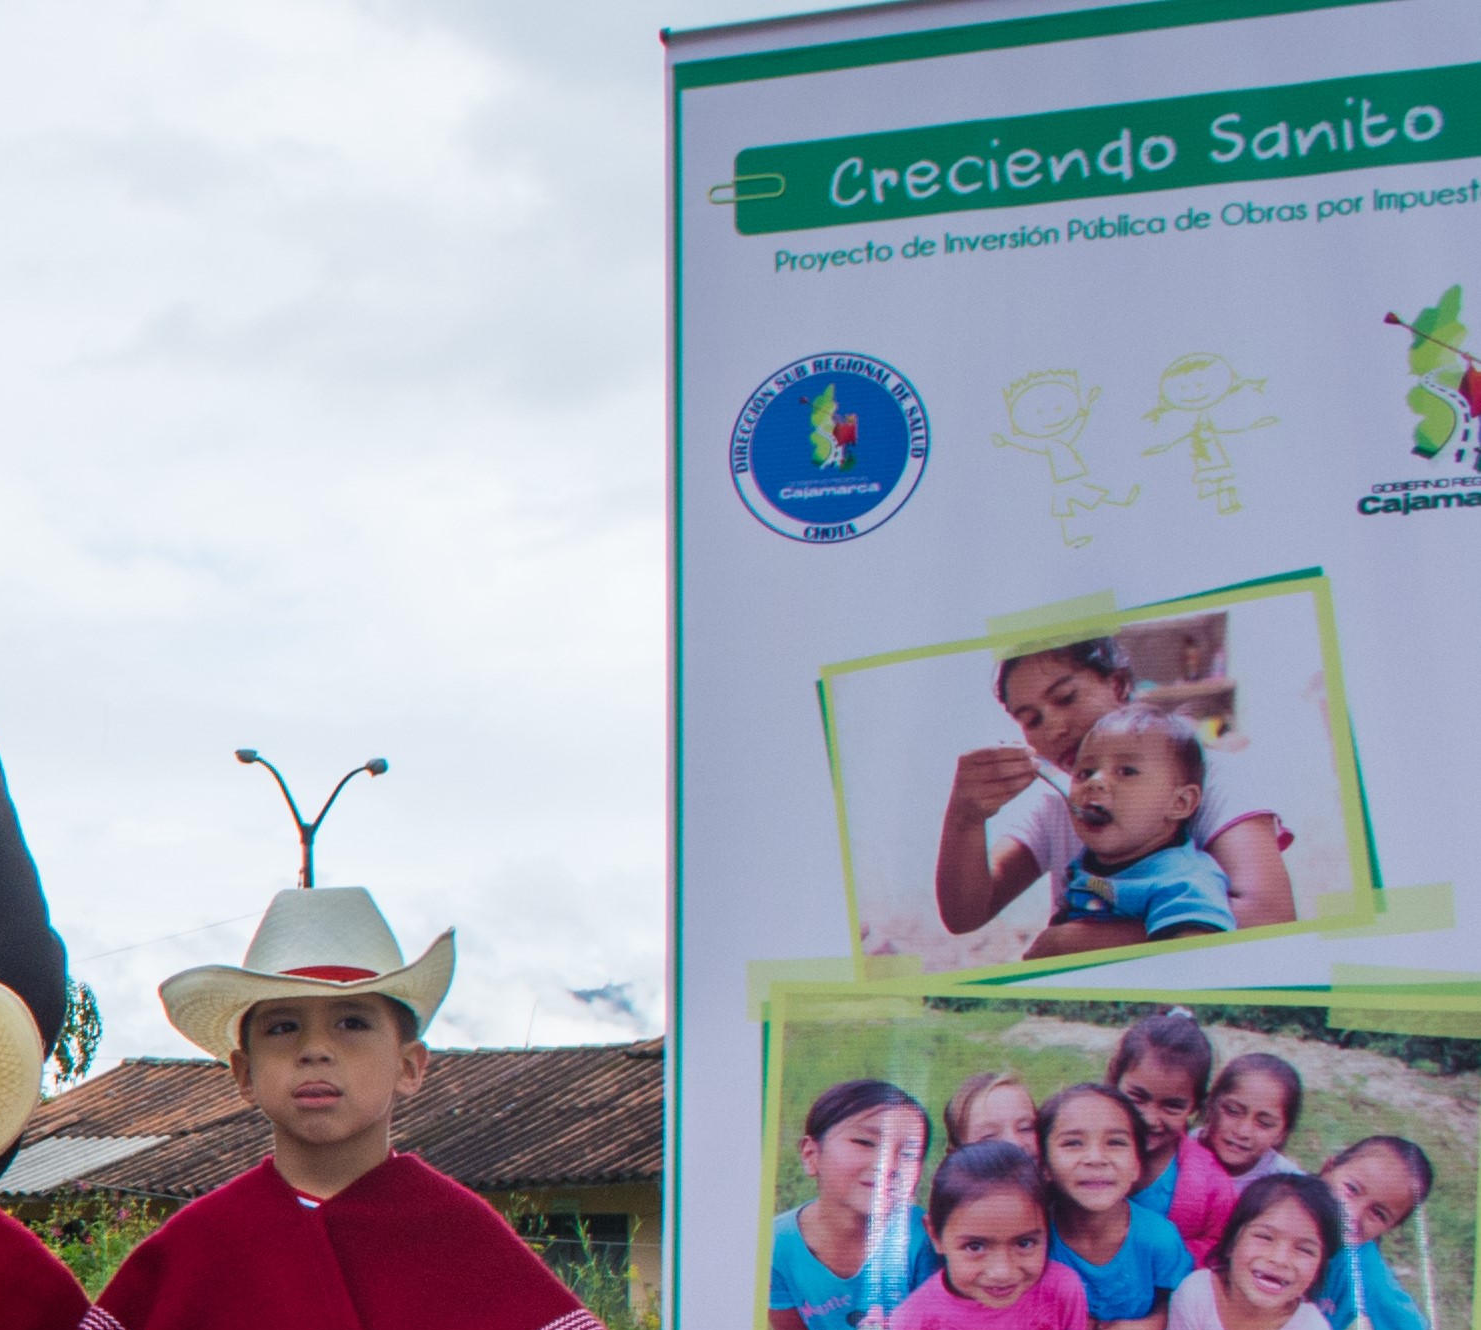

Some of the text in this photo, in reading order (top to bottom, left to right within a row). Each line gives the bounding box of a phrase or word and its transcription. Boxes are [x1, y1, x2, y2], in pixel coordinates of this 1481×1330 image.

[830, 96, 1444, 208] Creciendo Sanito
[774, 179, 1481, 273] Proyecto de Inversión Pública de Obras por Impuest
[774, 364, 809, 391] SUB
[811, 357, 892, 385] REGIONAL
[891, 382, 913, 402] DE
[907, 404, 926, 459] SALUD
[779, 481, 881, 500] Cajamarca
[1371, 478, 1450, 494] GOBIERNO
[803, 522, 857, 540] CHOTA
